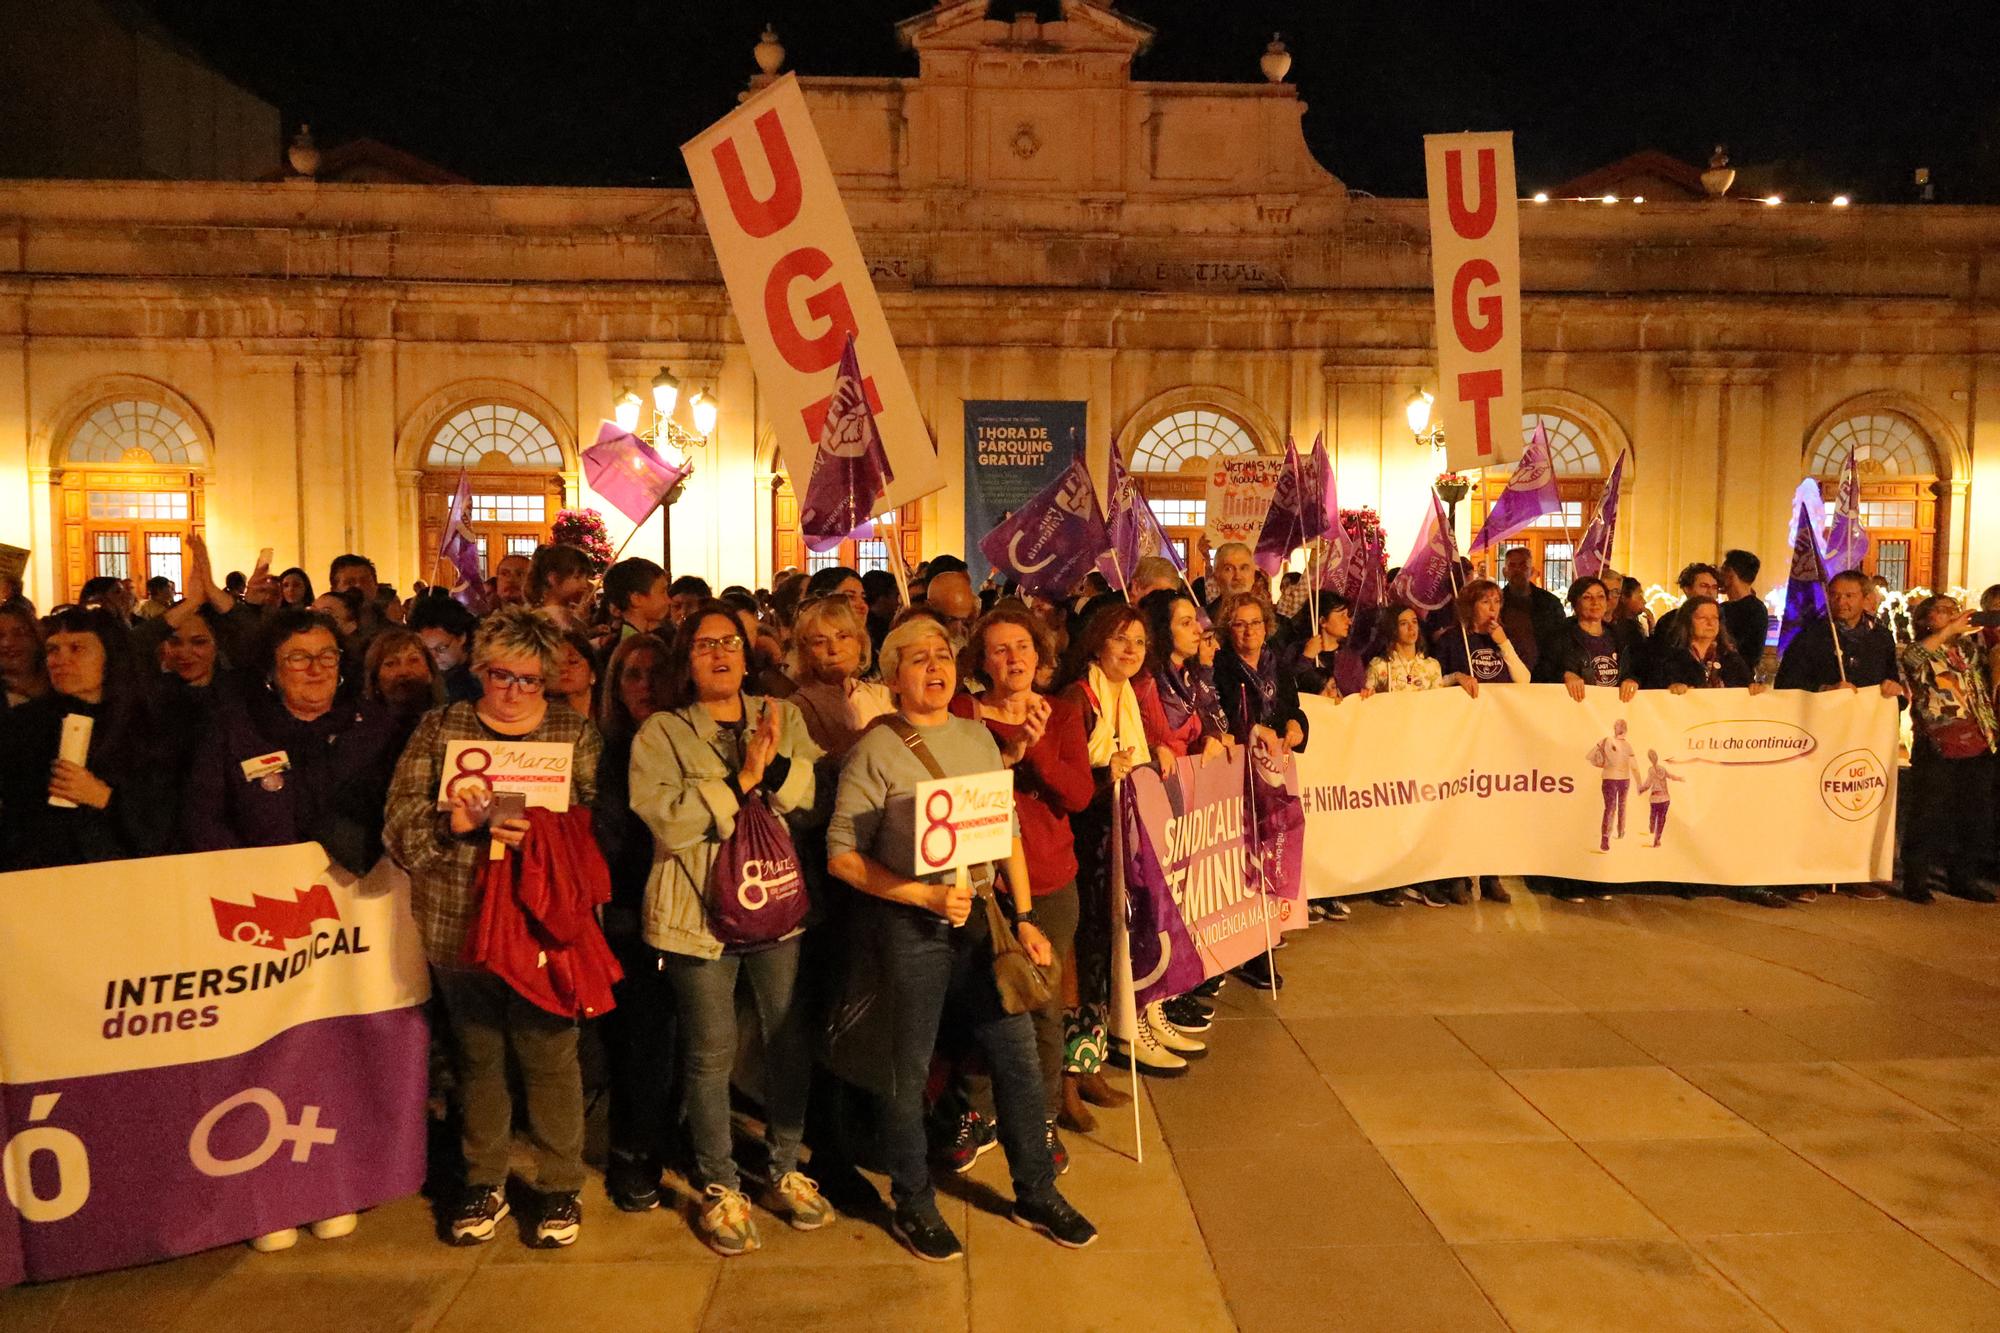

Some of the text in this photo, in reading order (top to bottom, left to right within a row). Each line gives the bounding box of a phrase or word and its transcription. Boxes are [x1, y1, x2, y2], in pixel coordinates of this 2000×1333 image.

[1445, 148, 1503, 456] UGT
[986, 427, 1026, 439] HORA
[1030, 427, 1049, 439] DE
[1745, 736, 1808, 749] continúa!
[499, 752, 568, 772] Marzo
[1824, 776, 1885, 793] FEMINISTA
[921, 789, 957, 867] 8
[738, 859, 768, 910] 8
[1203, 913, 1248, 947] VIOLÈNCIA
[104, 926, 370, 1010] INTERSINDICAL
[102, 1004, 219, 1039] dones
